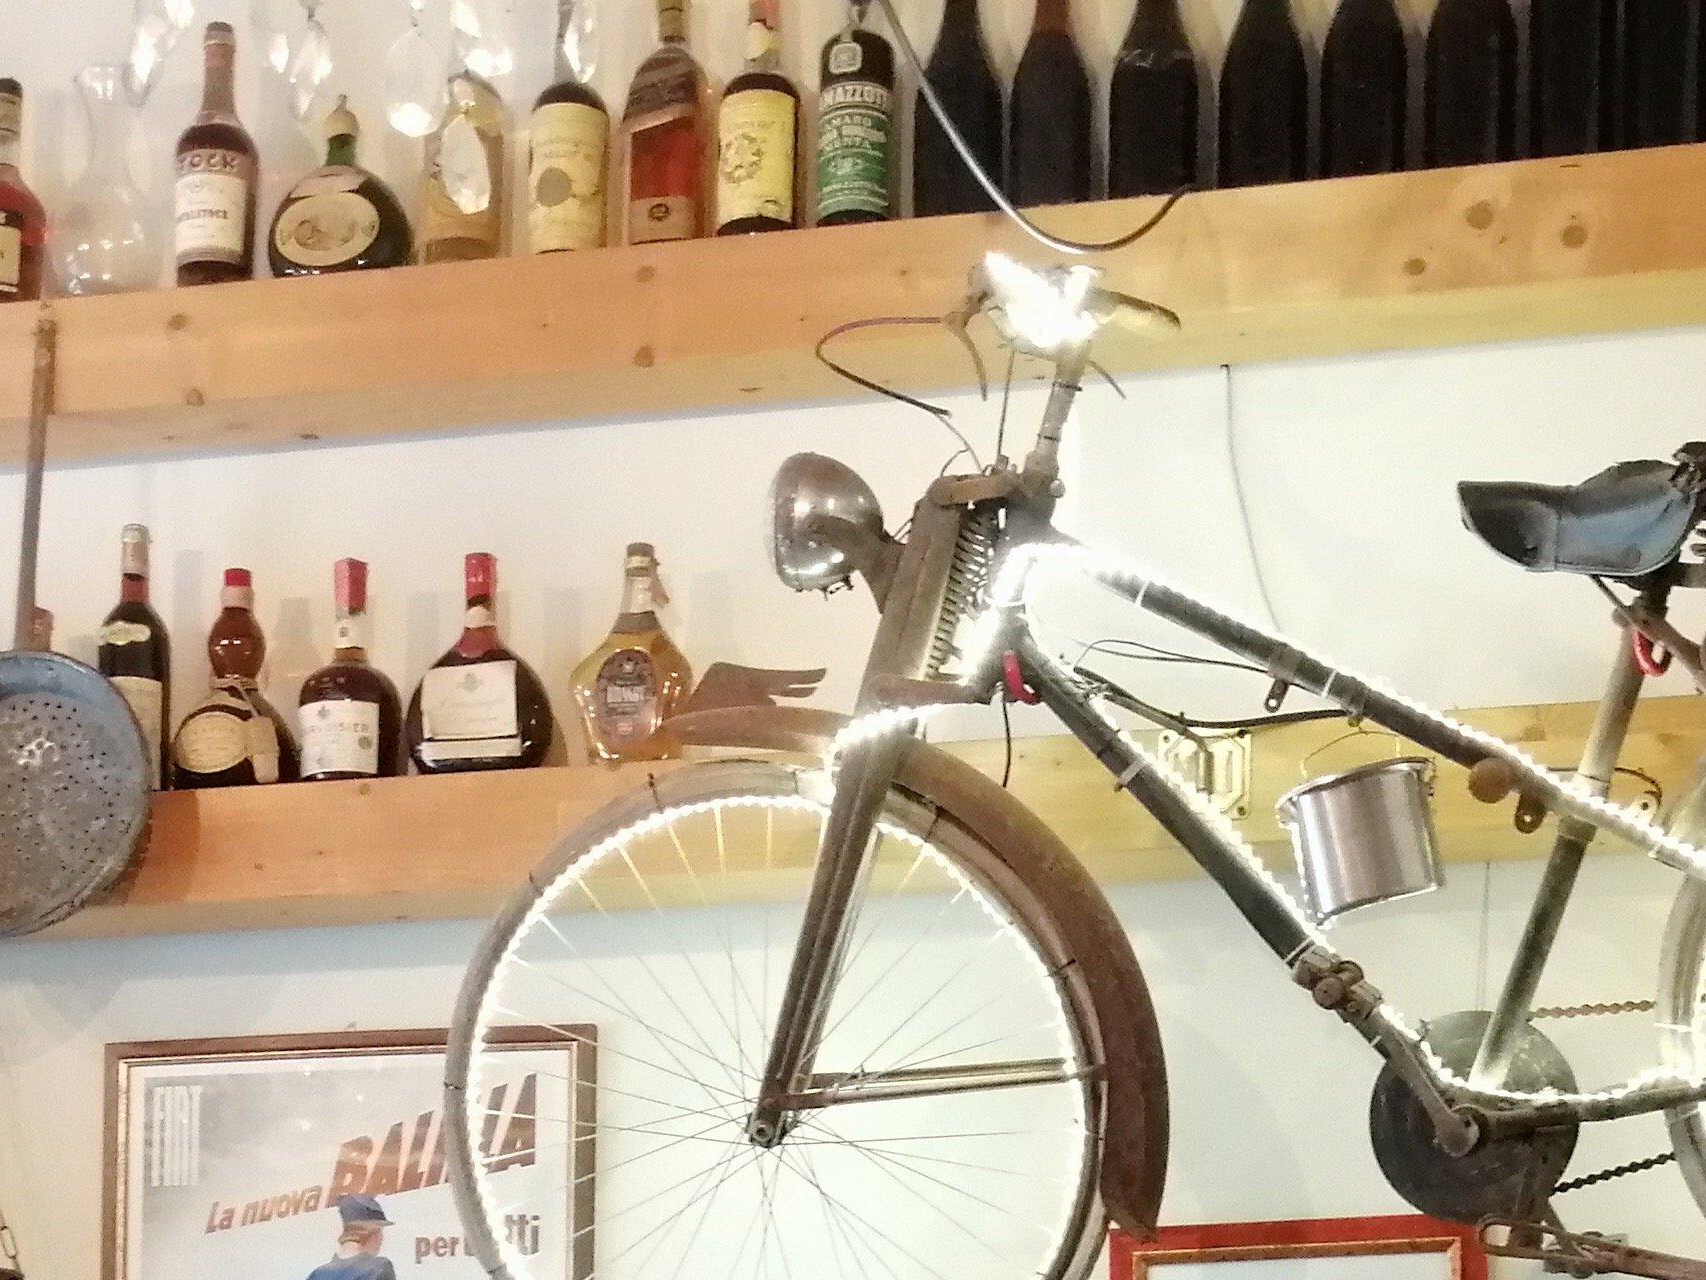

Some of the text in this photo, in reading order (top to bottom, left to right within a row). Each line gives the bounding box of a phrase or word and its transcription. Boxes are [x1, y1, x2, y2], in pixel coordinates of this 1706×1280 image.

[205, 1202, 233, 1234] La
[241, 1184, 323, 1226] nuova
[415, 1235, 458, 1265] per
